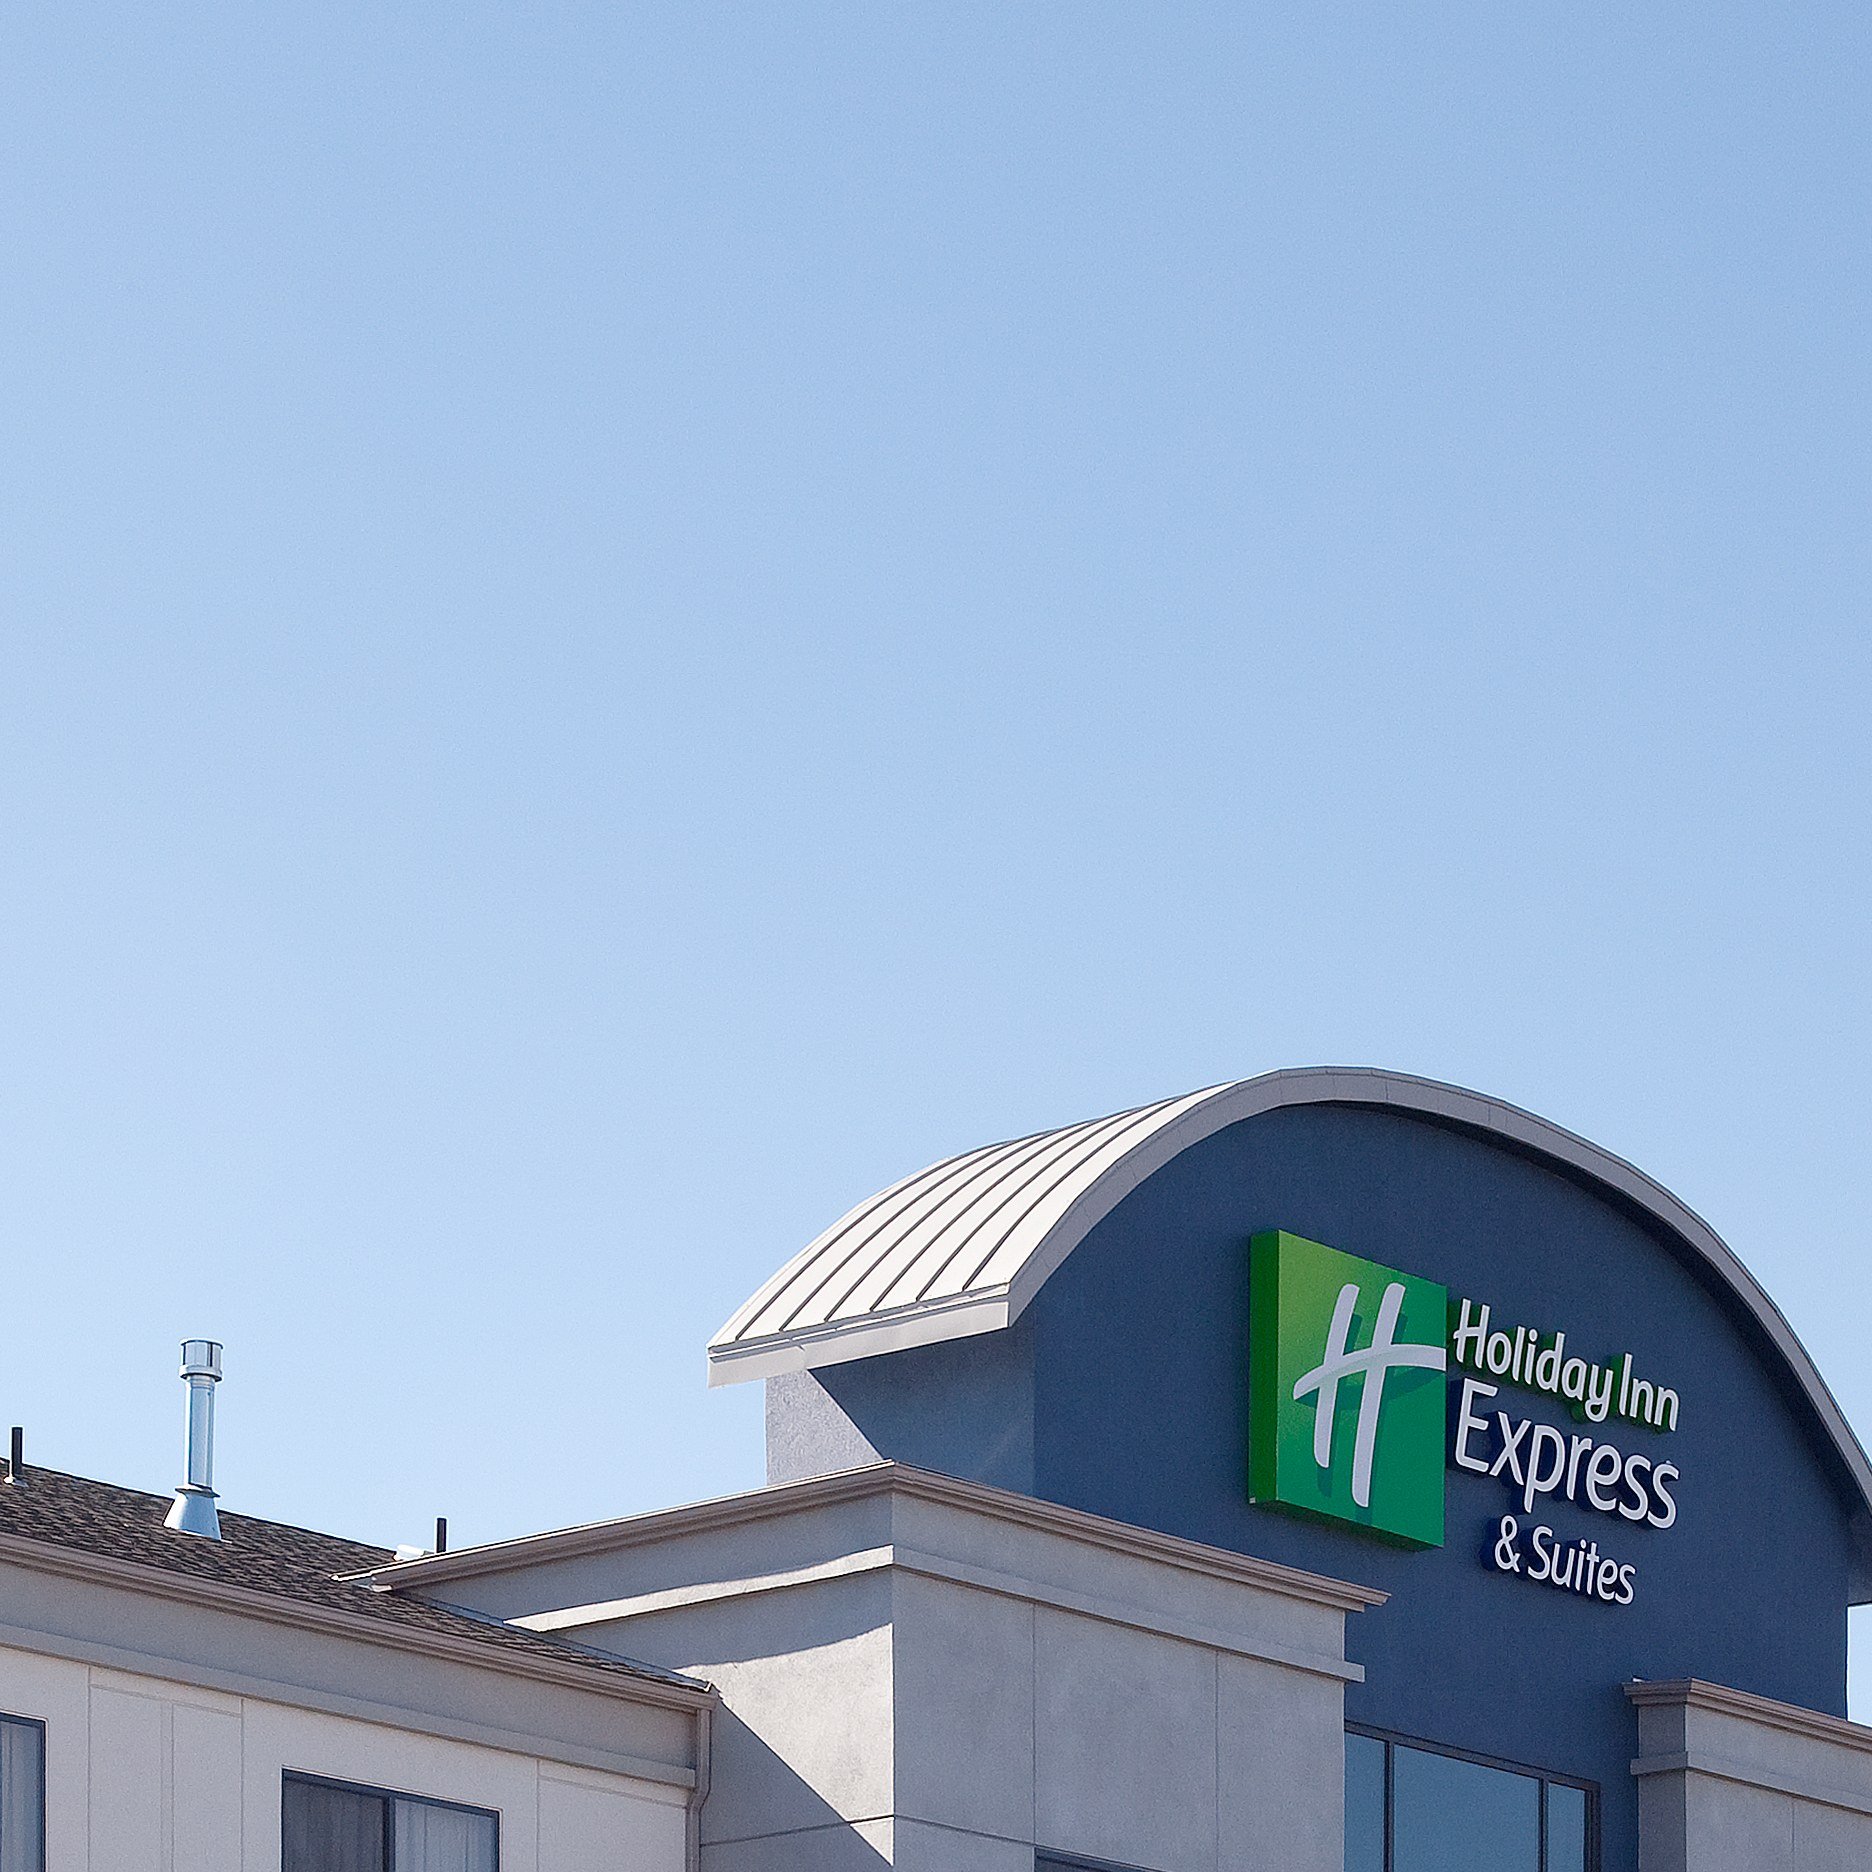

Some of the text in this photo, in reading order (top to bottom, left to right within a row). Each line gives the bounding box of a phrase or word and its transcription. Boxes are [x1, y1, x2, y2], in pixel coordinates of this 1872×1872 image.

[1453, 1297, 1680, 1432] Holiday Inn
[1454, 1377, 1680, 1529] Express
[1494, 1515, 1636, 1605] & Suites
